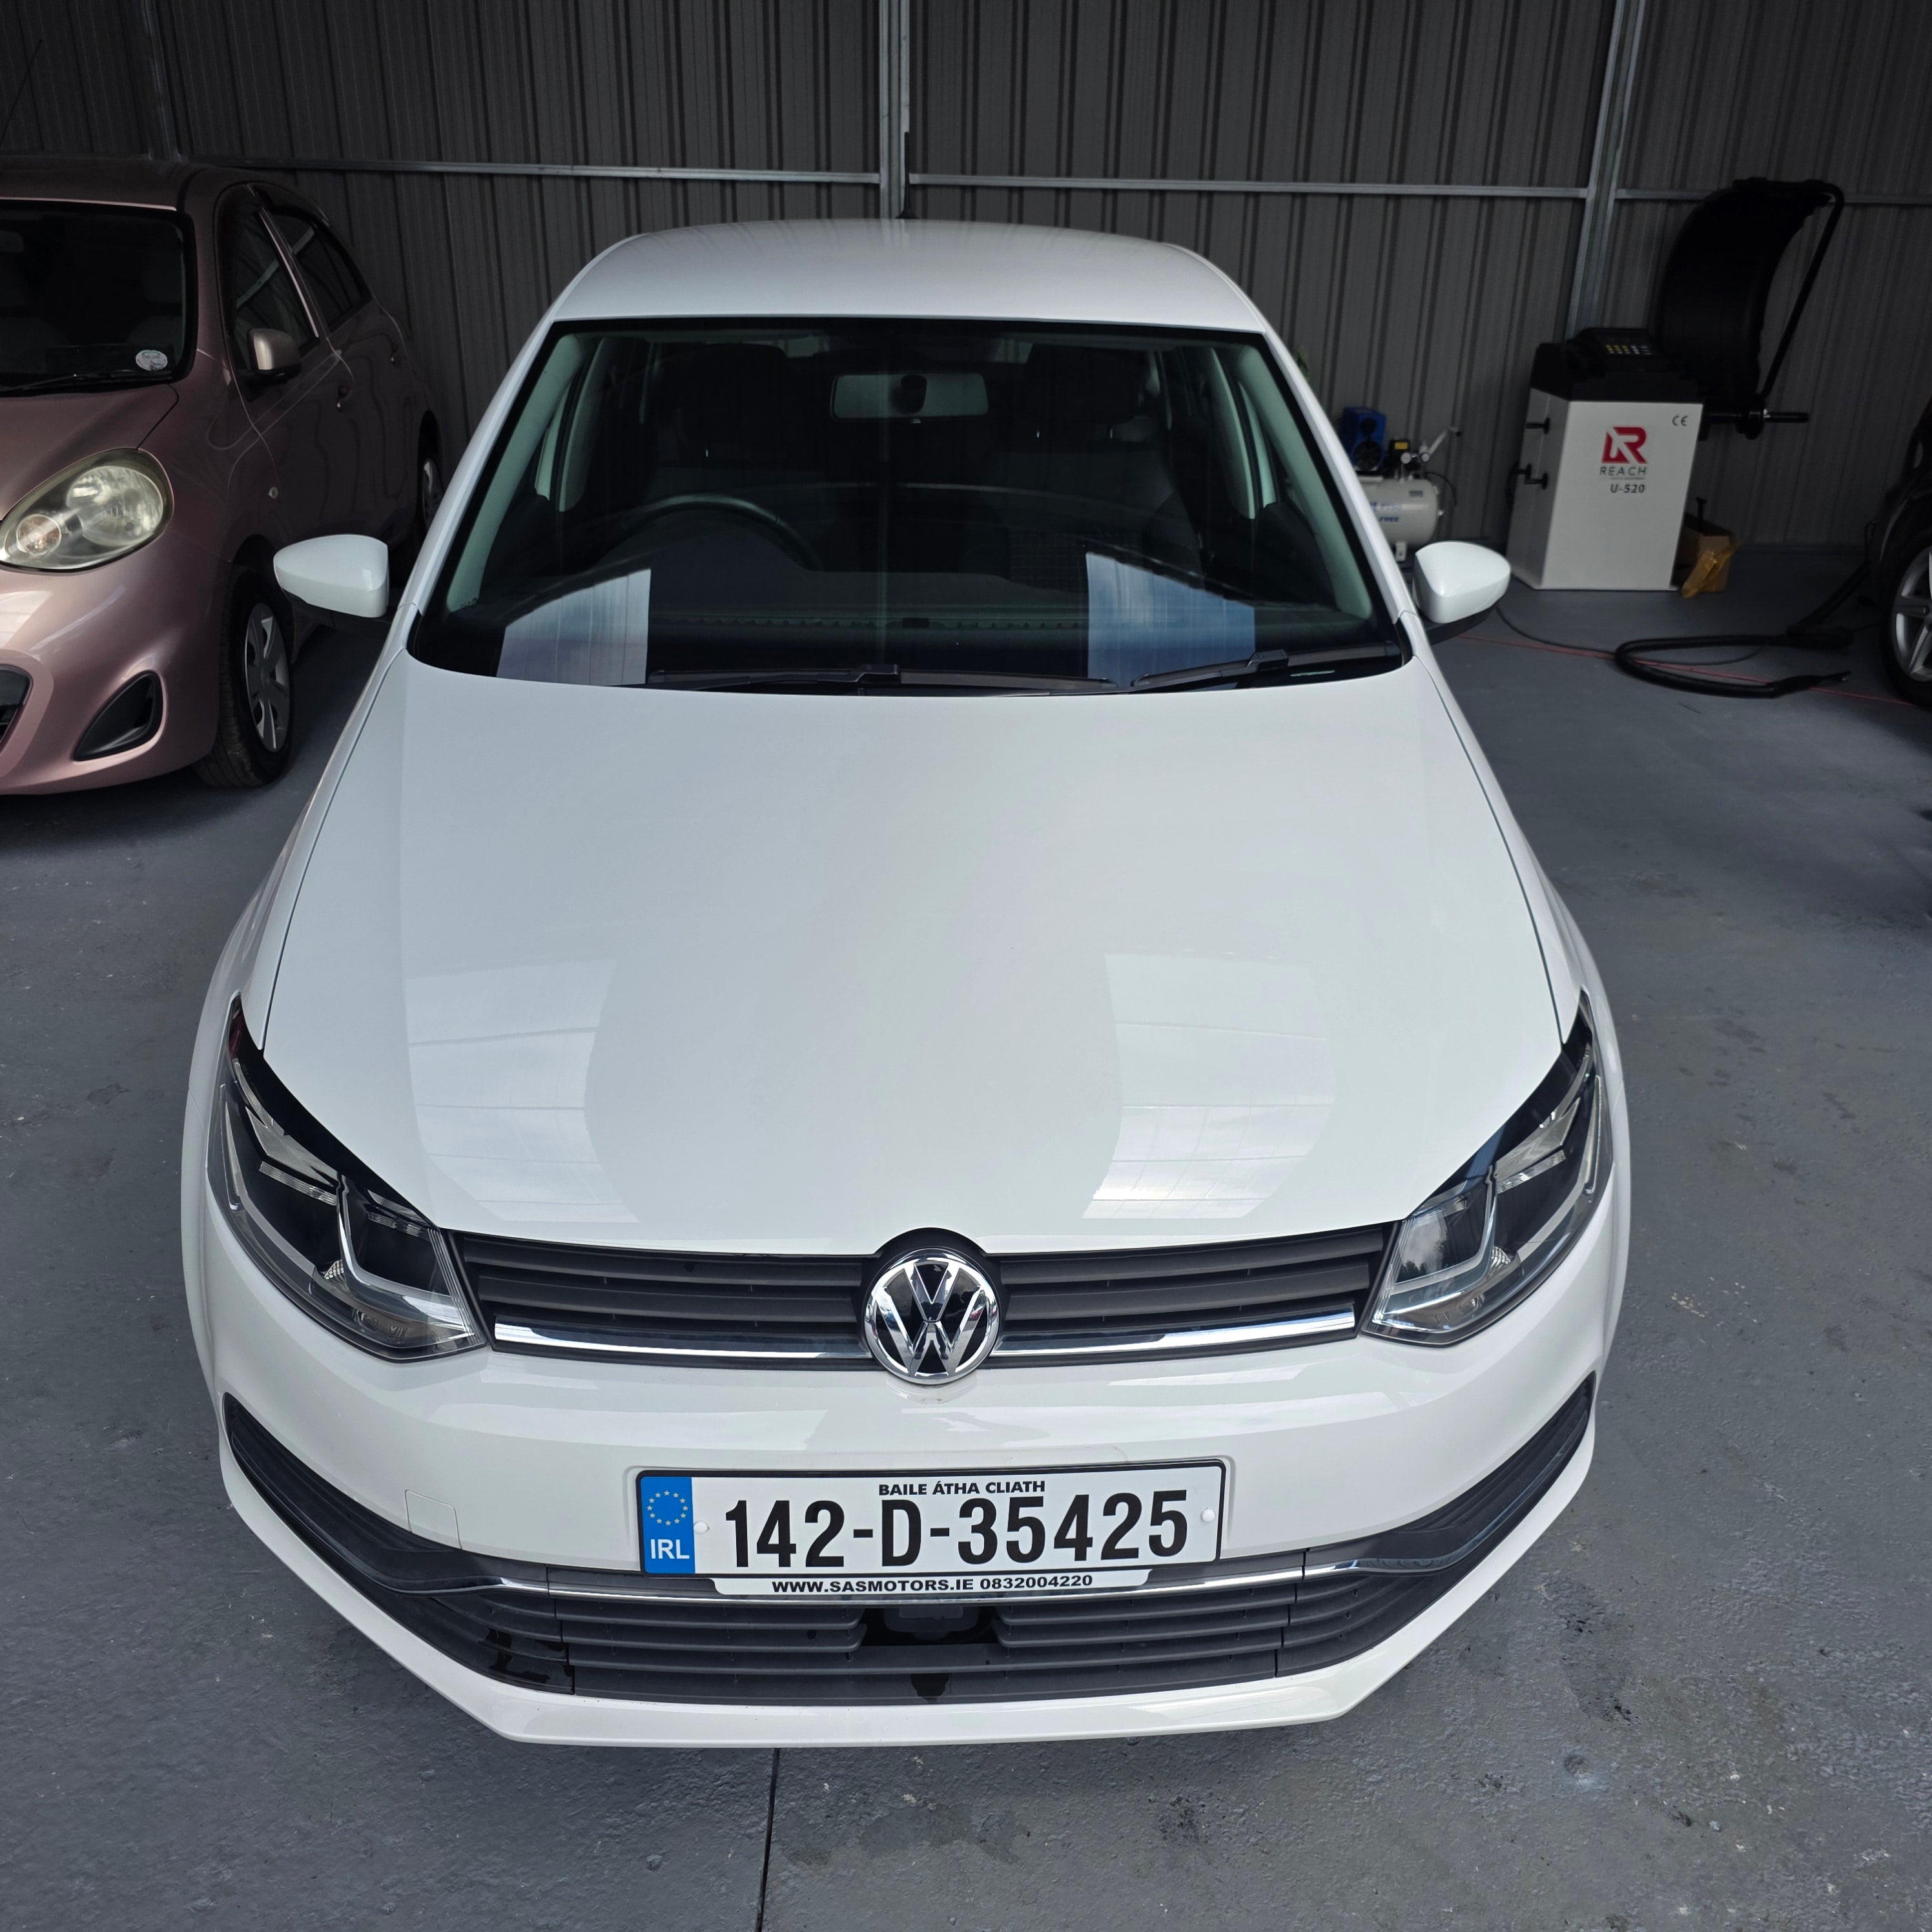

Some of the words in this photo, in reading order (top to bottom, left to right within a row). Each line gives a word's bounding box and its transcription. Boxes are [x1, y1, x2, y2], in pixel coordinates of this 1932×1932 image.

[1672, 415, 1689, 426] CE
[1599, 466, 1647, 476] REACH
[1610, 484, 1645, 493] U-520
[879, 1484, 927, 1496] BAILE
[932, 1481, 980, 1495] ÁTHA
[985, 1481, 1045, 1494] CLIATH
[725, 1490, 1187, 1568] 142-D-35425
[650, 1539, 690, 1559] IRL
[772, 1579, 974, 1592] WWW.SASMOTORS.IE
[980, 1575, 1093, 1590] 0832004220
